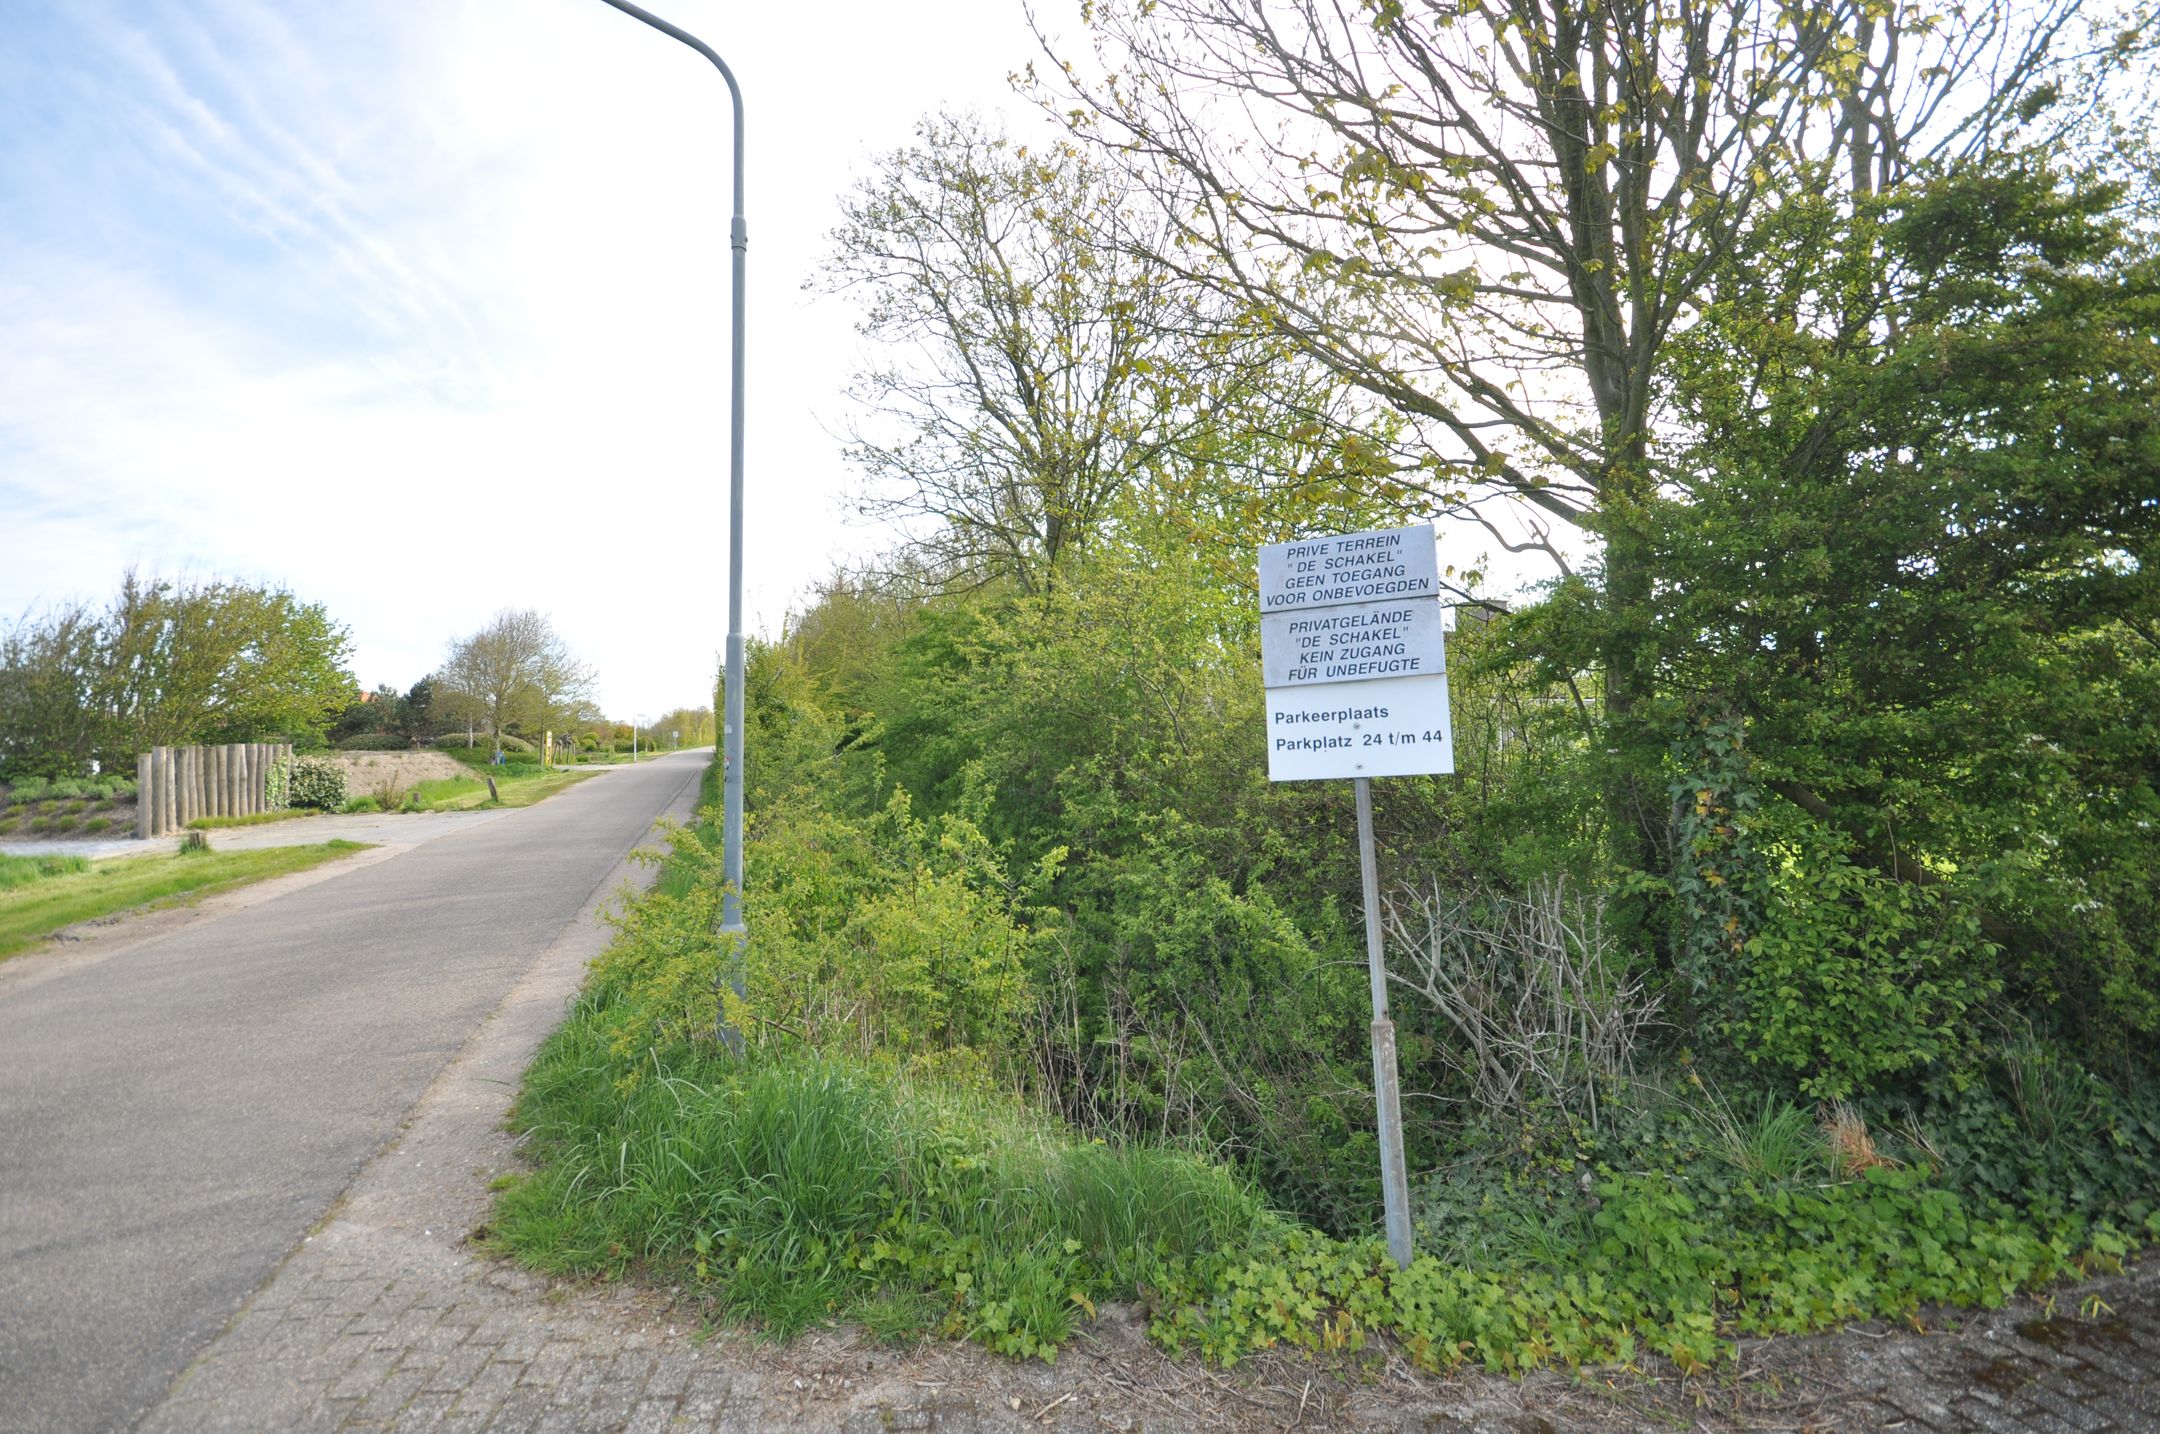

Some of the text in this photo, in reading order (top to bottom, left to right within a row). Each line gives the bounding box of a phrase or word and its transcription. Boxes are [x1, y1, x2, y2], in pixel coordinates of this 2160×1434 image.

[1287, 535, 1401, 559] PRIVE TERREIN
[1285, 565, 1405, 589] GEEN TOEGANG
[1267, 578, 1429, 607] VOOR ONBEVOEGDEN
[1289, 610, 1413, 634] PRIVATGELÄNDE
[1300, 643, 1405, 664] KEIN ZUGANG
[1289, 658, 1420, 680] FÜR UNBEFUGTE
[1275, 706, 1389, 724] Parkeerplaats
[1276, 730, 1443, 752] Parkplatz 24 t/m 44
